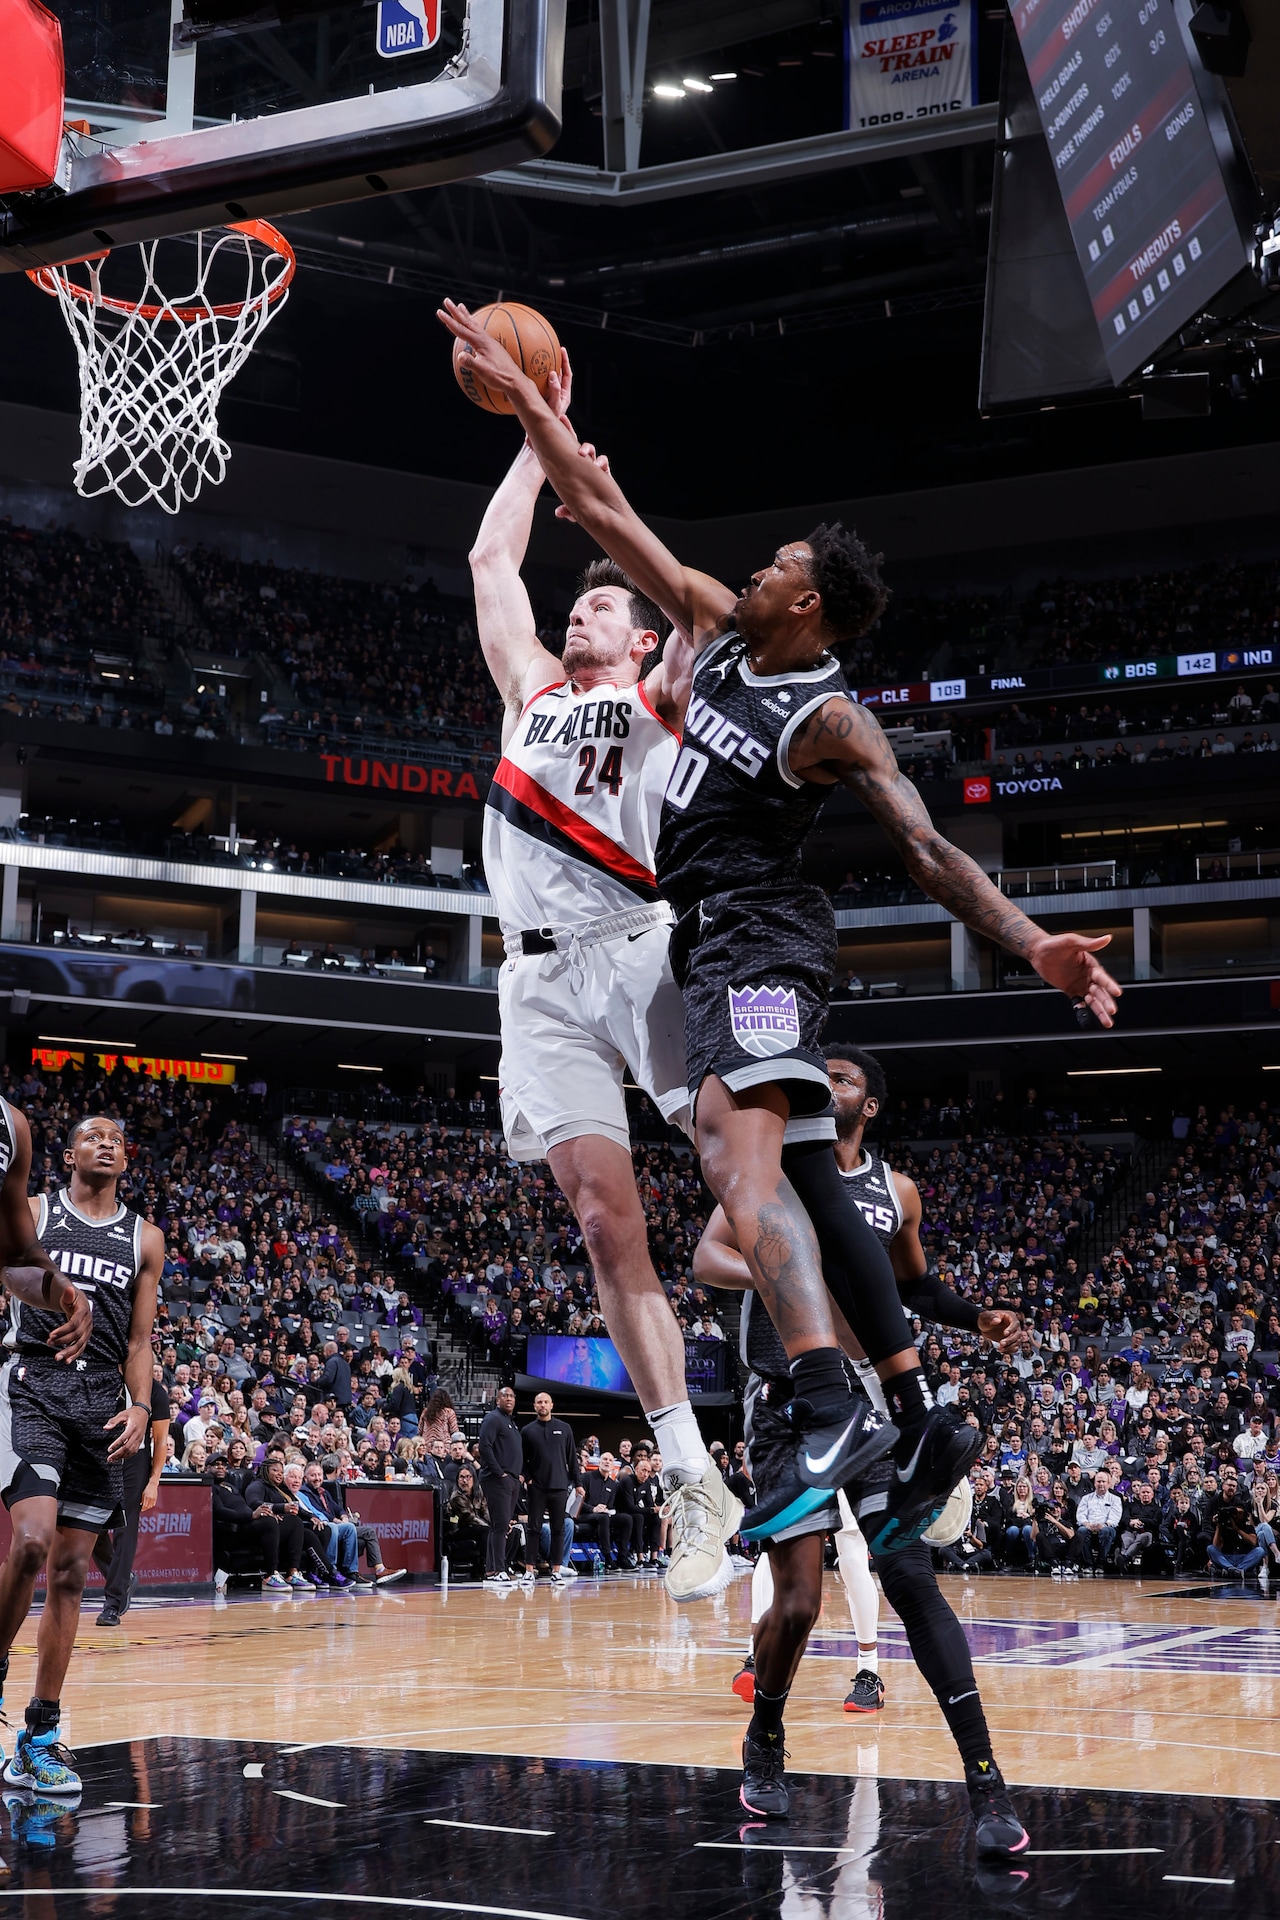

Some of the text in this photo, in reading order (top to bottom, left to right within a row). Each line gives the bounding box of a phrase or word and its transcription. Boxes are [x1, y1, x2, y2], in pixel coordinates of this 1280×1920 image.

[878, 3, 912, 16] ARCO
[386, 20, 416, 48] NBA
[861, 28, 936, 58] SLEEP
[880, 43, 955, 74] TRAIN
[891, 66, 940, 85] ARENA
[1039, 50, 1083, 111] FIELD GOALS
[1055, 104, 1105, 170] FREE THROWS
[1165, 102, 1195, 141] BONUS
[1108, 123, 1142, 170] FOULS
[1092, 165, 1139, 222] TEAM FOULS
[1129, 219, 1182, 281] TIMEOUTS
[881, 649, 1272, 704] CLE 109 FINAL BOS 142 IND
[523, 700, 633, 747] BLAZERS
[760, 698, 792, 719] dialpad
[684, 691, 771, 779] KNGS
[320, 754, 480, 800] TUNDRA
[574, 745, 624, 797] 24
[996, 777, 1063, 795] TOYOTA
[734, 1016, 799, 1033] KINGS
[735, 1005, 796, 1015] SACRAMENTO
[139, 1569, 181, 1580] SACRAMENTO
[181, 1567, 199, 1577] KINGS
